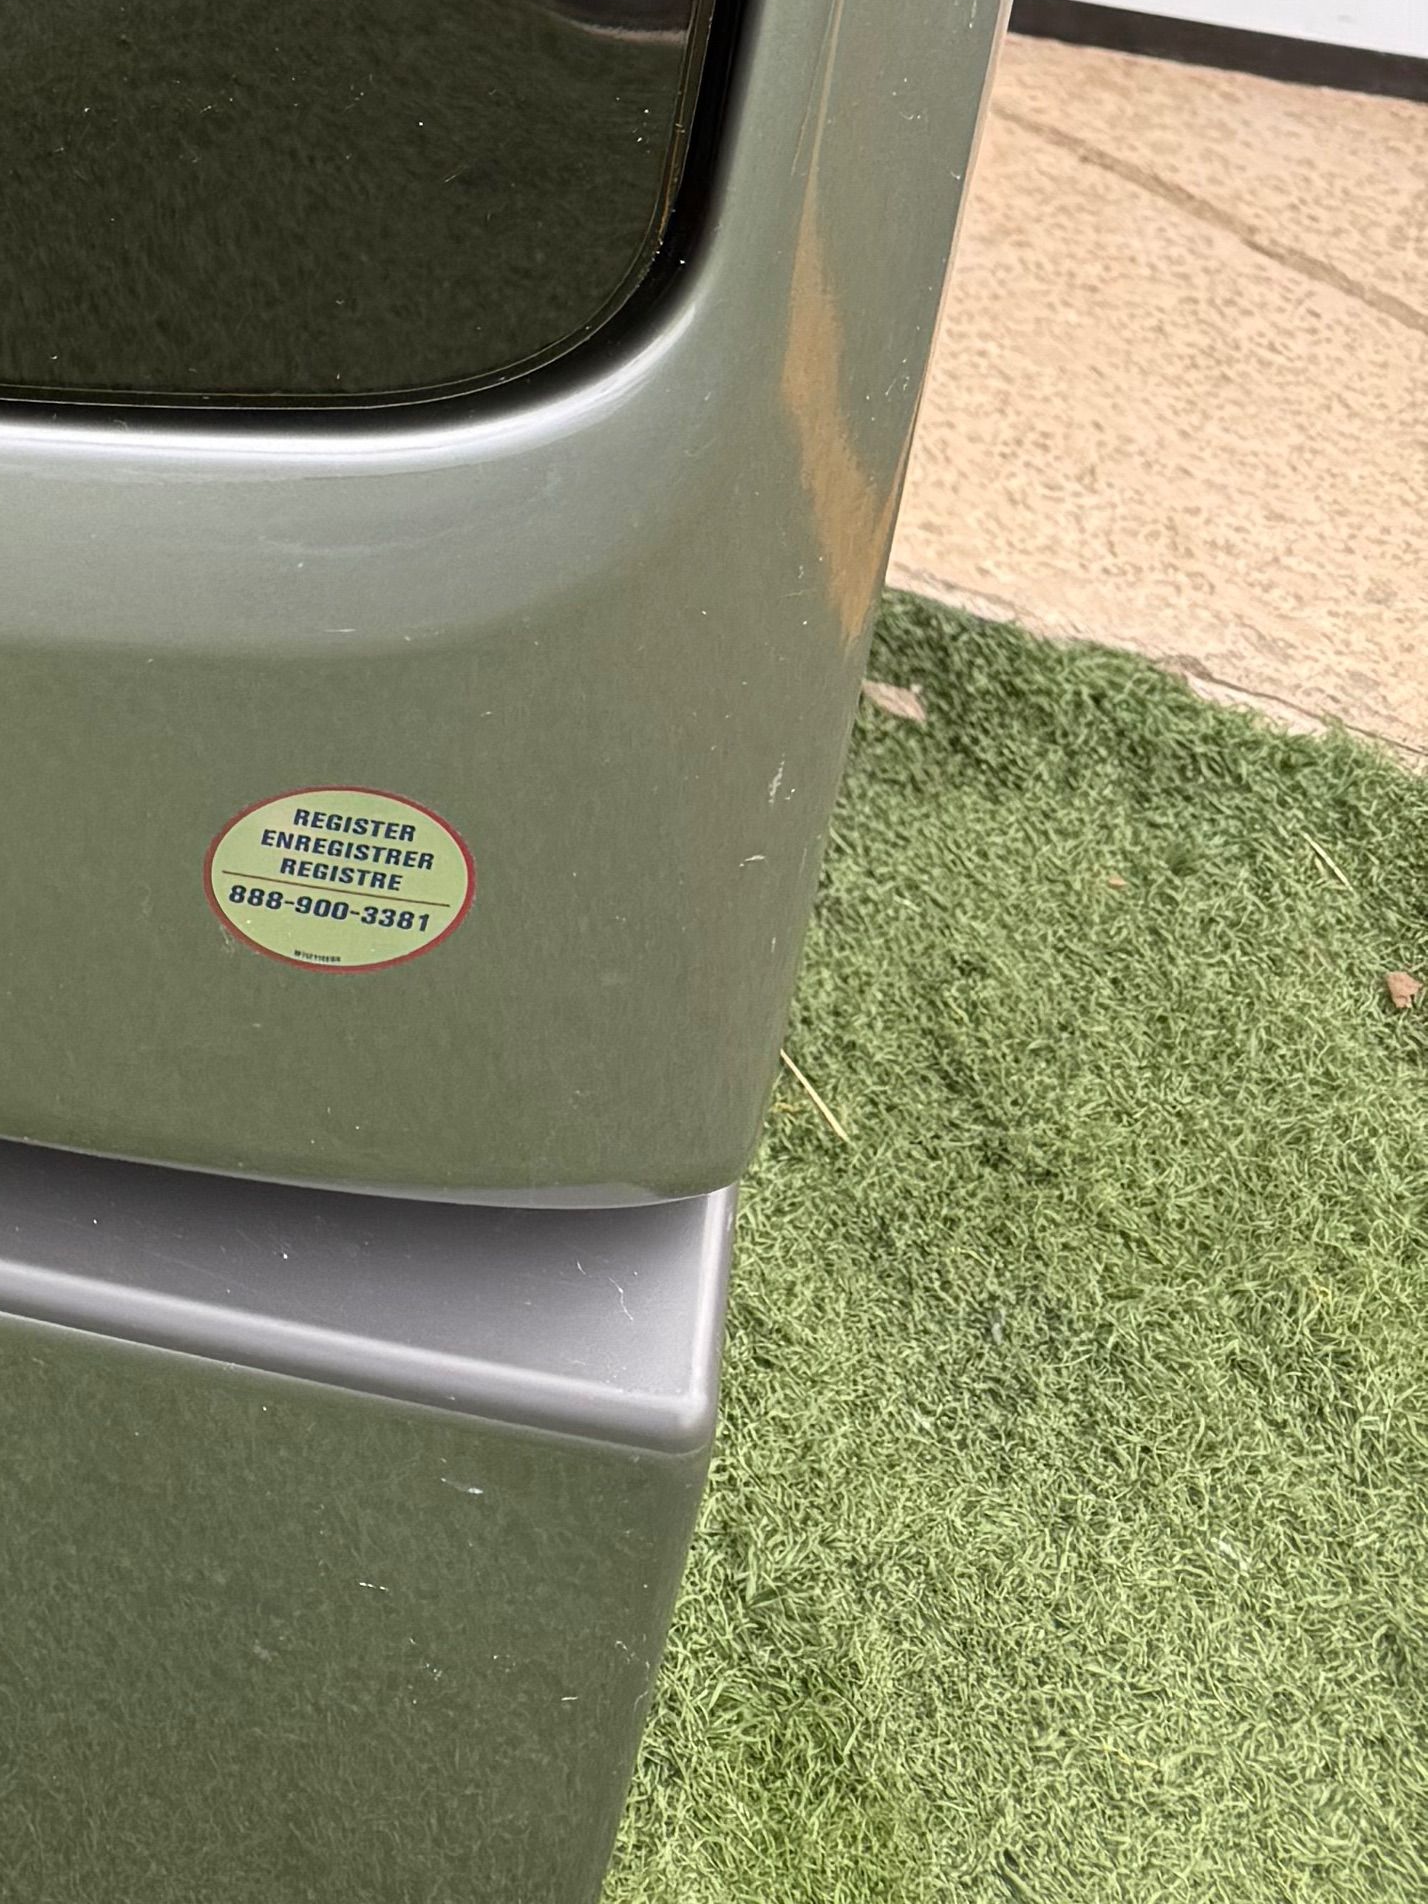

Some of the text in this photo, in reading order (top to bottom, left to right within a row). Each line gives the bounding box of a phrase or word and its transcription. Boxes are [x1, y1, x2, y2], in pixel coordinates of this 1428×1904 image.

[293, 808, 417, 843] REGISTER
[260, 828, 435, 871] ENREGISTRER
[279, 857, 404, 892] REGISTRE
[228, 884, 431, 933] 888-900-3381
